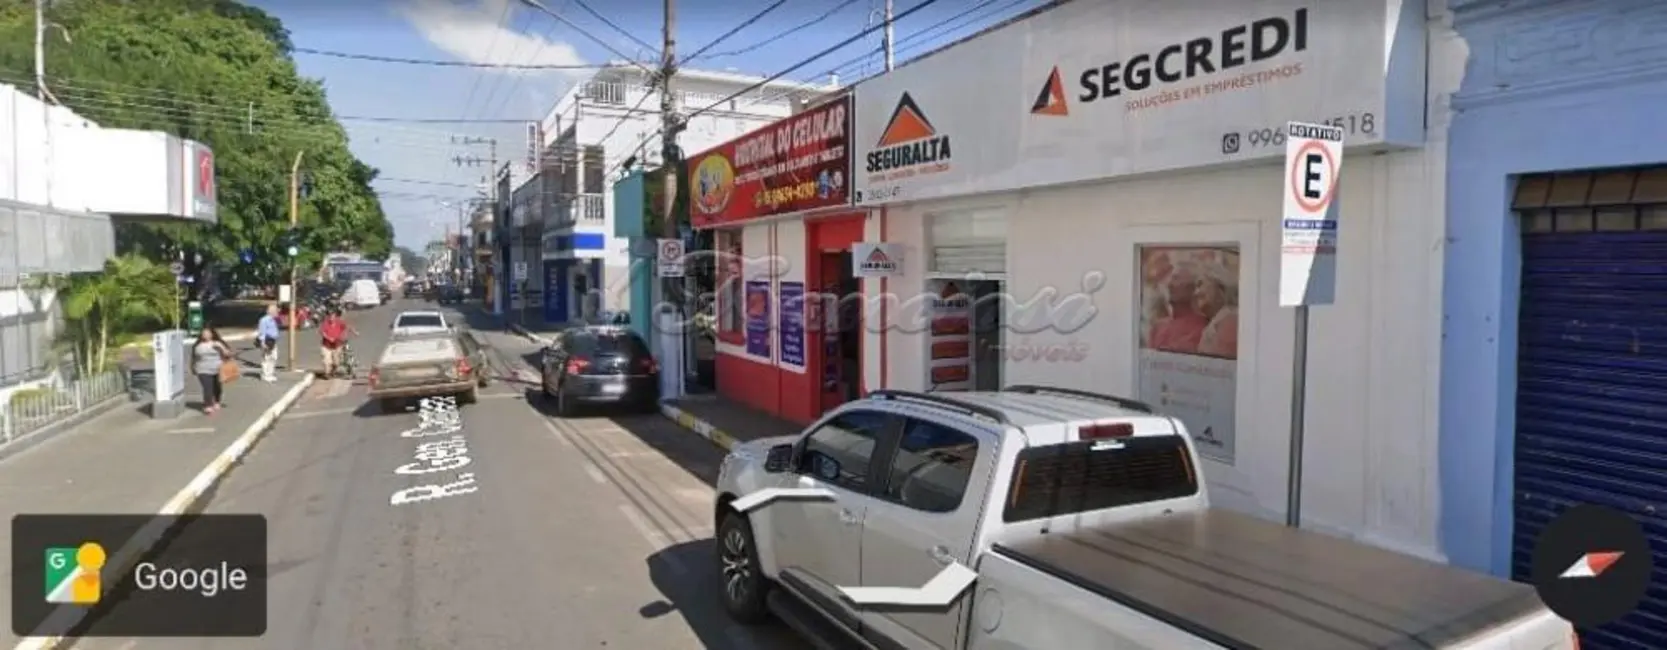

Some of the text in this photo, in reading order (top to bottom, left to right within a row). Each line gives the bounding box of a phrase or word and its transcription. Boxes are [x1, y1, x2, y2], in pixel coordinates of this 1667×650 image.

[1079, 8, 1308, 102] SEGCREDI
[1183, 85, 1202, 100] EM
[777, 123, 790, 154] DO
[793, 104, 845, 149] CELULAR
[1290, 123, 1341, 141] ROTATIVO
[867, 135, 951, 173] SEGURALTA
[1304, 154, 1322, 199] E
